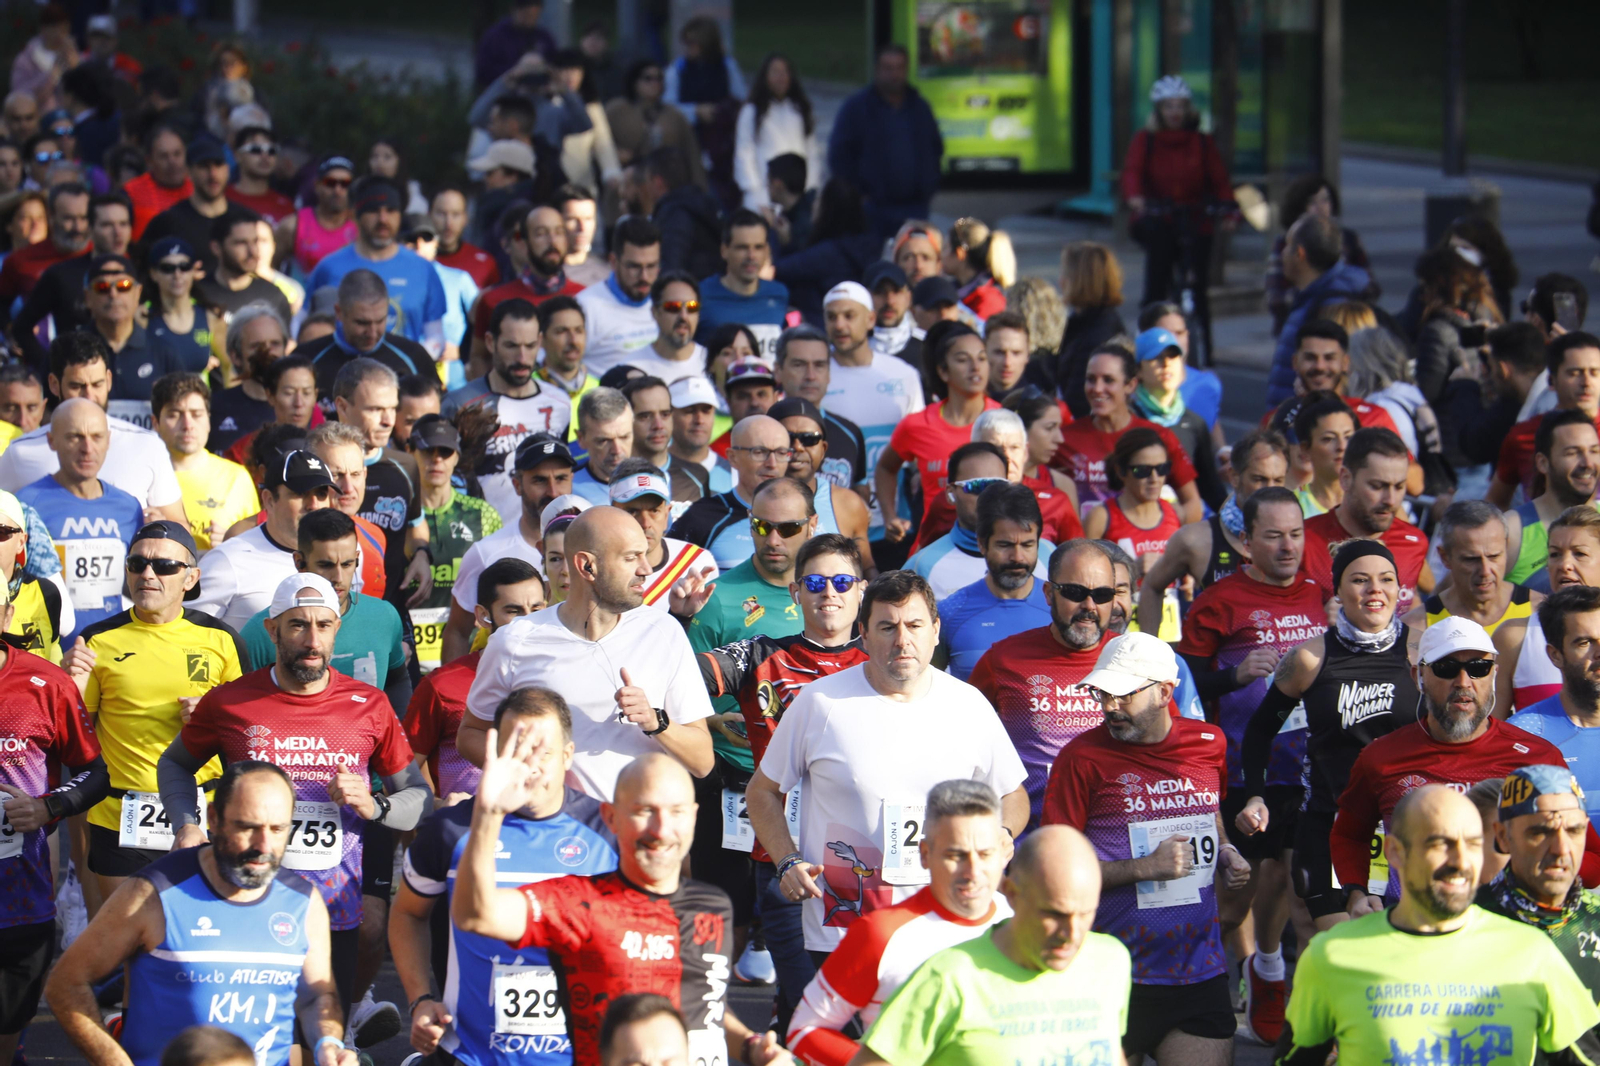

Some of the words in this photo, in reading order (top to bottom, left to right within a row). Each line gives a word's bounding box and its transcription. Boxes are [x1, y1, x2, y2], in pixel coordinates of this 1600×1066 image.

[75, 556, 114, 578] 857
[1274, 614, 1312, 629] MEDIA
[1255, 629, 1276, 645] 36
[1029, 697, 1051, 712] 36
[274, 737, 328, 750] MEDIA
[247, 750, 269, 763] 36
[275, 749, 360, 766] MARATÓN
[285, 770, 331, 780] ÓRDOBA
[1145, 778, 1195, 795] MEDIA
[1124, 796, 1146, 813] 36
[1150, 788, 1219, 811] MARATÓN
[126, 813, 134, 834] CAJÓN
[1159, 822, 1192, 833] IMDECO
[286, 820, 337, 848] 753
[903, 820, 919, 847] 2
[1365, 983, 1433, 1001] CARRERA
[1437, 983, 1501, 999] URBANA
[503, 988, 559, 1018] 329
[1420, 1002, 1440, 1016] DE
